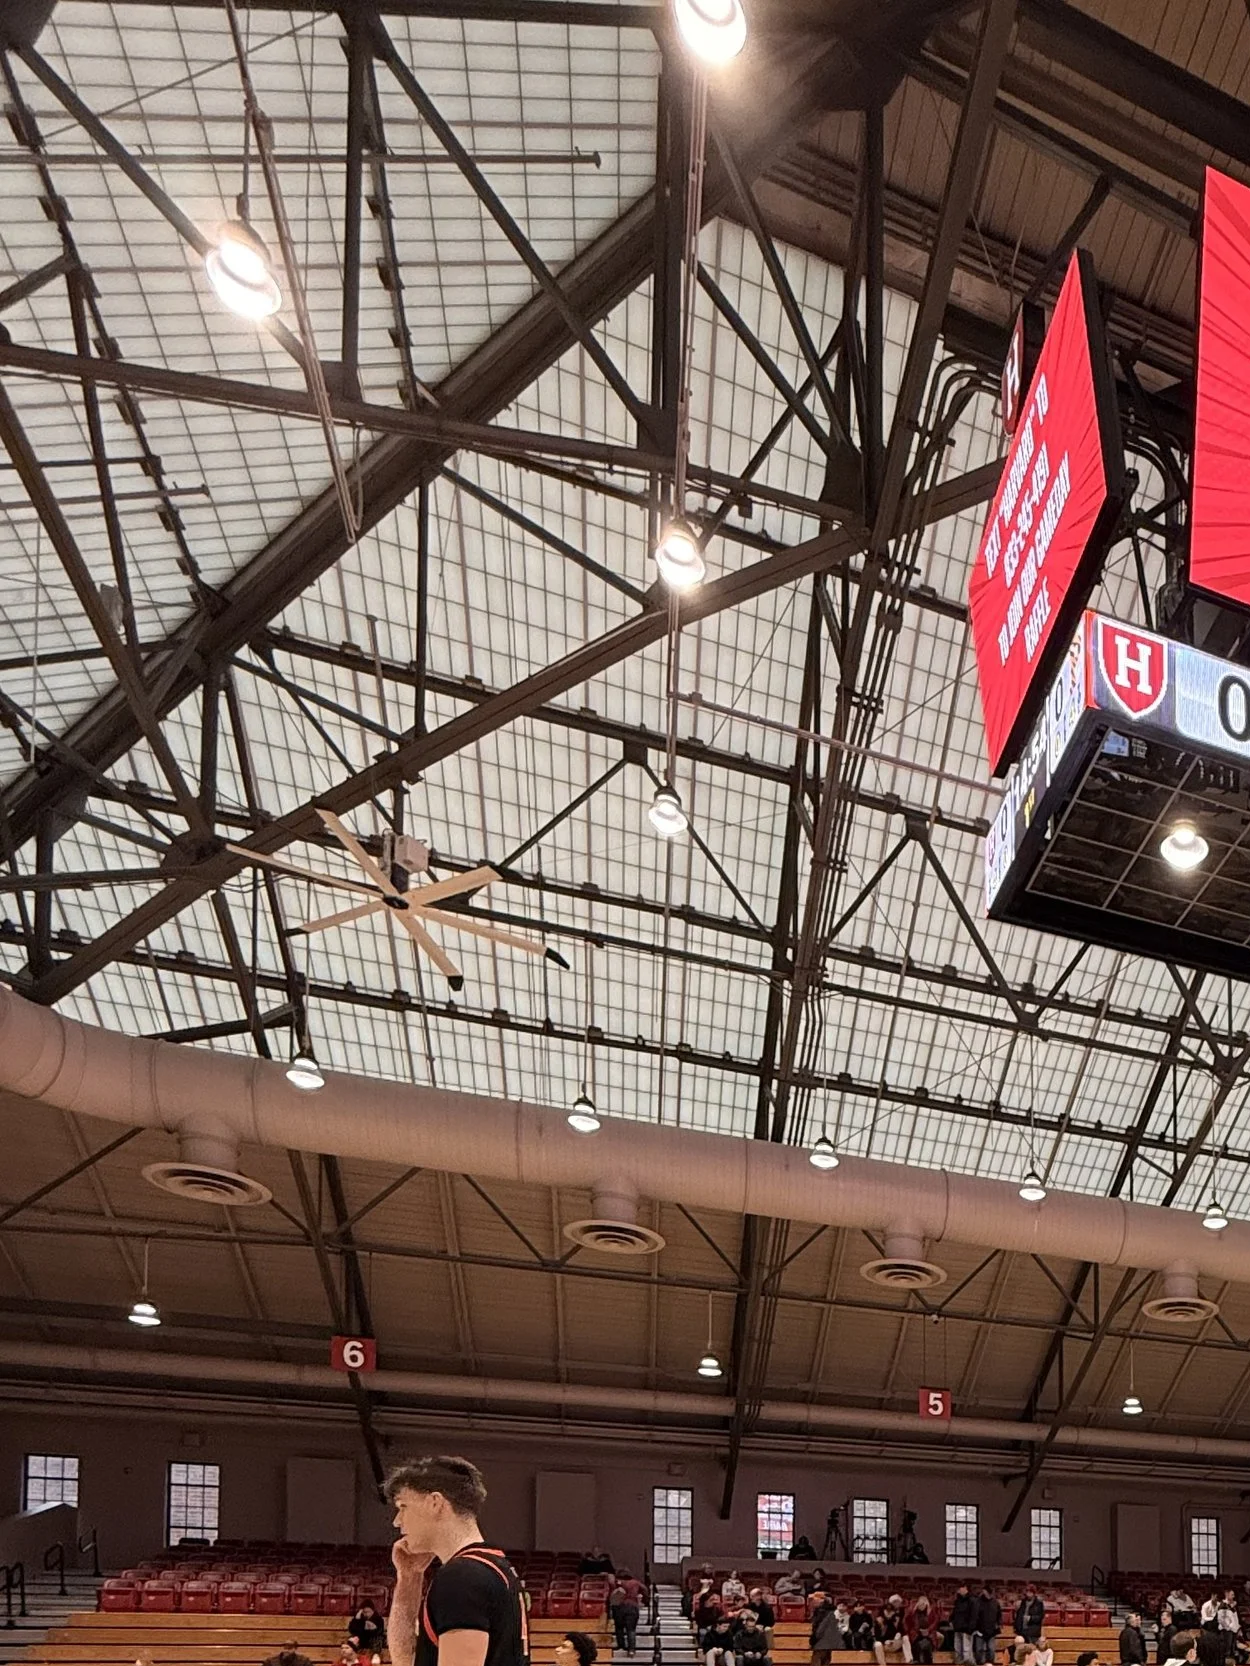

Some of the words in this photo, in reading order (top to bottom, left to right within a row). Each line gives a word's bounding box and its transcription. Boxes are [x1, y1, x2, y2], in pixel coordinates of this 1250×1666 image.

[1114, 634, 1152, 696] H
[343, 1341, 365, 1369] 6
[927, 1392, 944, 1417] 5
